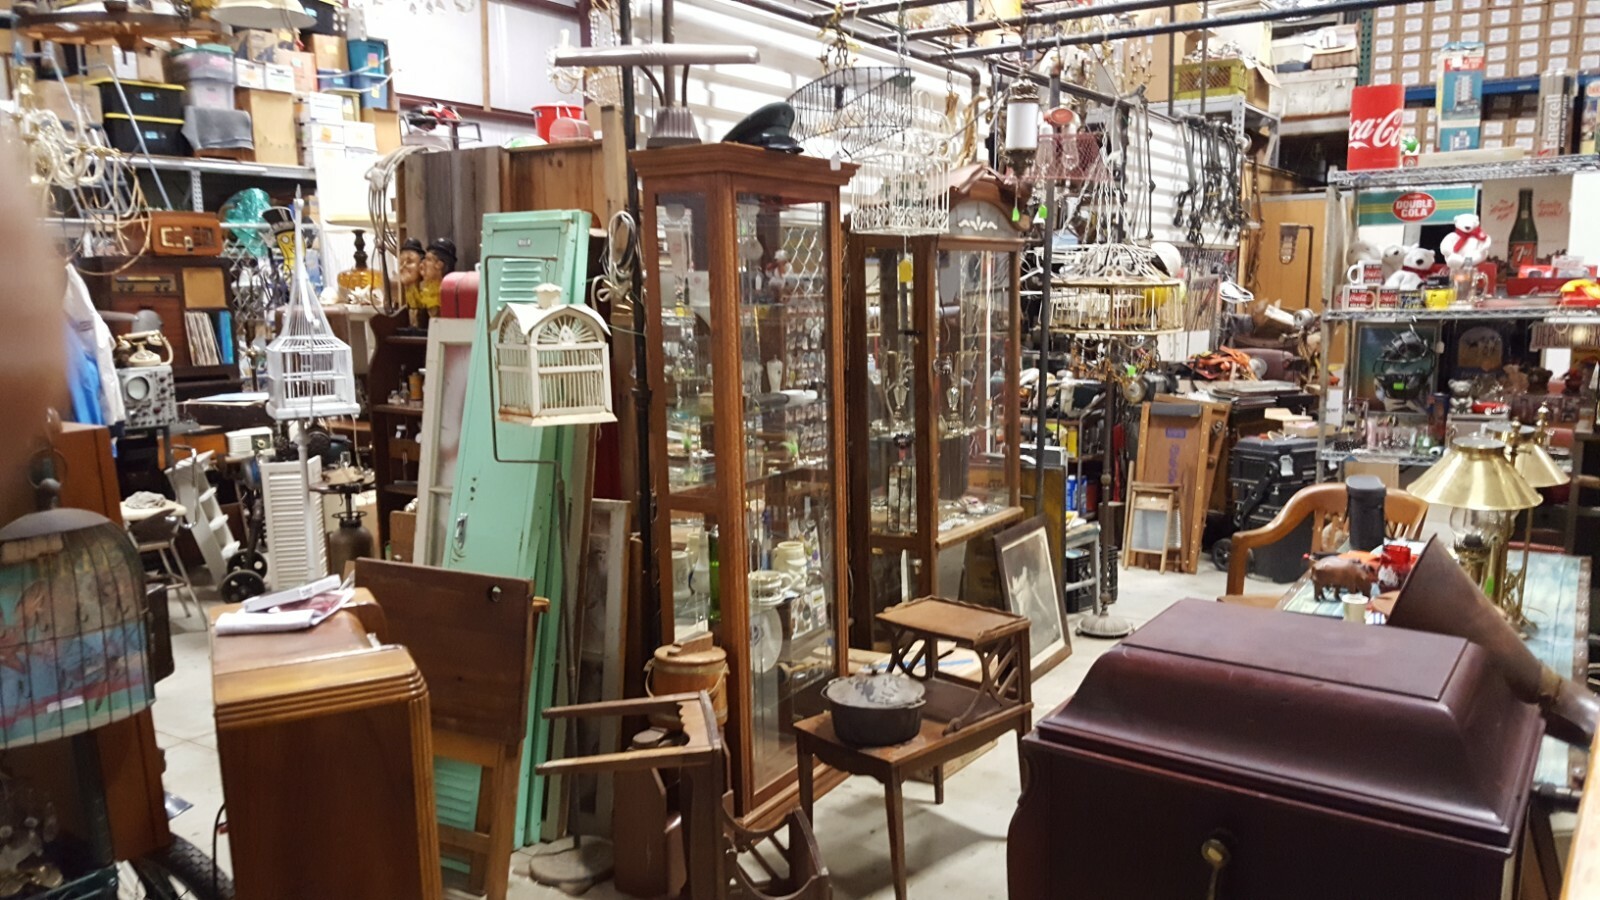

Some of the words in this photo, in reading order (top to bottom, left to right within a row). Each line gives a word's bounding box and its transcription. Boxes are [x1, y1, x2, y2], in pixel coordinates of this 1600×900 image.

[1543, 94, 1561, 149] Enercell
[1396, 199, 1433, 209] DOUBLE
[1401, 208, 1428, 217] COLA
